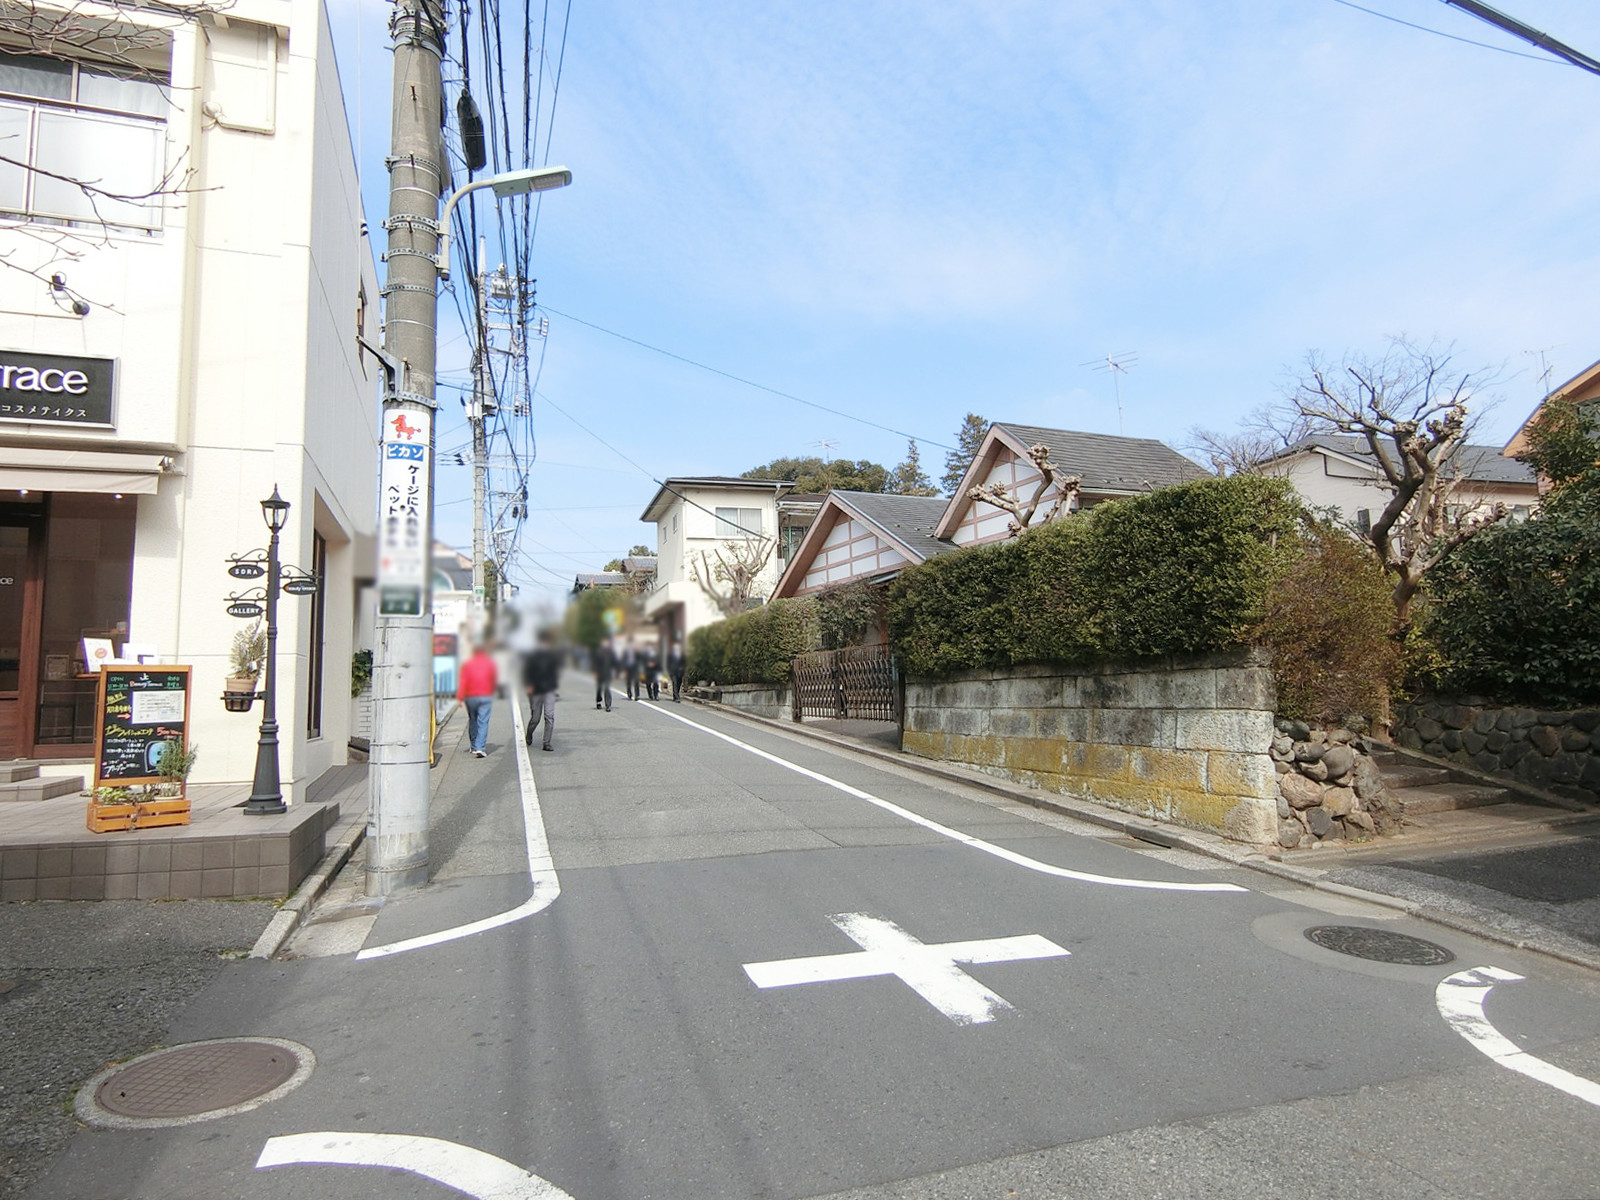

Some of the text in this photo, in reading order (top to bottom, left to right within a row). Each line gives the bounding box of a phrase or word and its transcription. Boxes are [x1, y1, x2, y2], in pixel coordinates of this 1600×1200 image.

[0, 365, 88, 394] race
[386, 484, 400, 547] ペット
[406, 464, 420, 547] ケージに入
